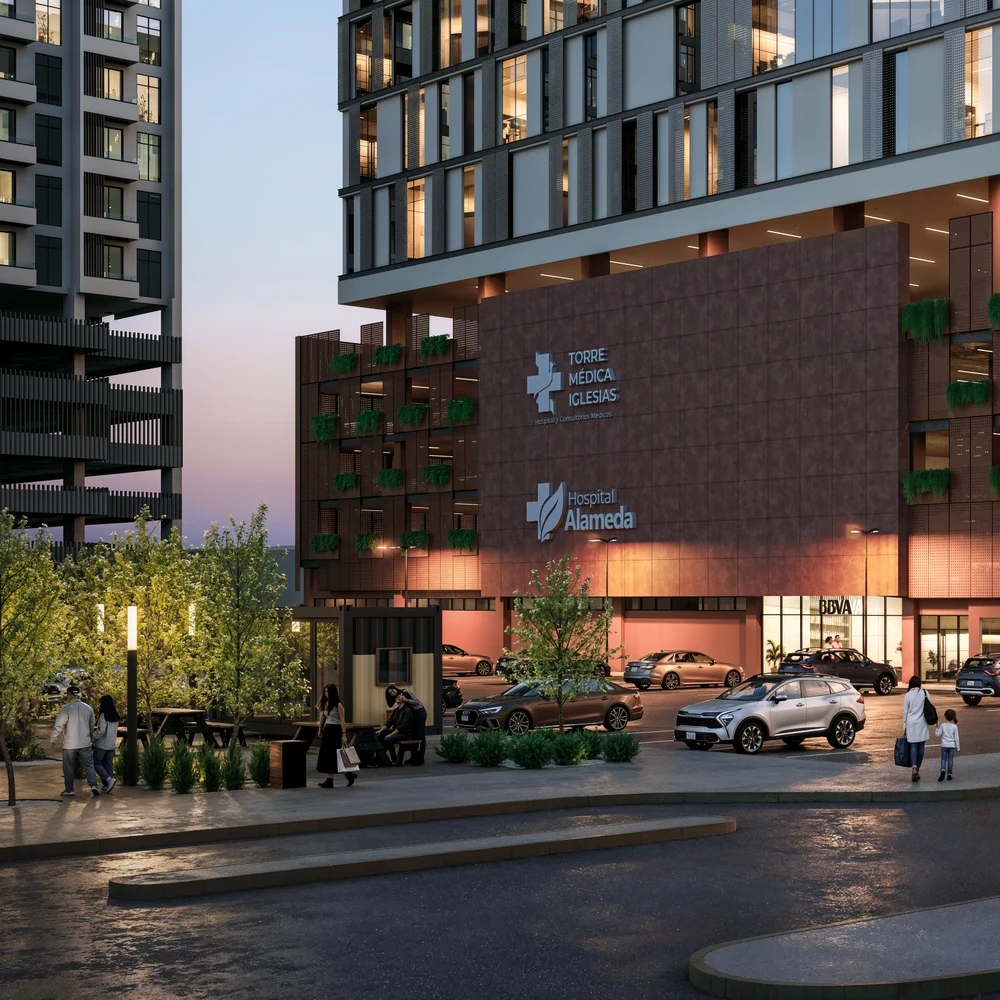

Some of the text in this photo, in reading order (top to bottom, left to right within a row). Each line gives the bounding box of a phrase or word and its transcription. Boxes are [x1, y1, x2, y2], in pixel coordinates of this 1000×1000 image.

[568, 347, 607, 365] TORRE
[568, 367, 614, 386] MÉDICA
[568, 387, 618, 406] IGLESIAS
[535, 417, 555, 426] Hospital
[559, 413, 590, 423] Consultorios
[568, 488, 616, 508] Hospital
[564, 506, 635, 531] Alameda
[819, 599, 852, 615] BBVA
